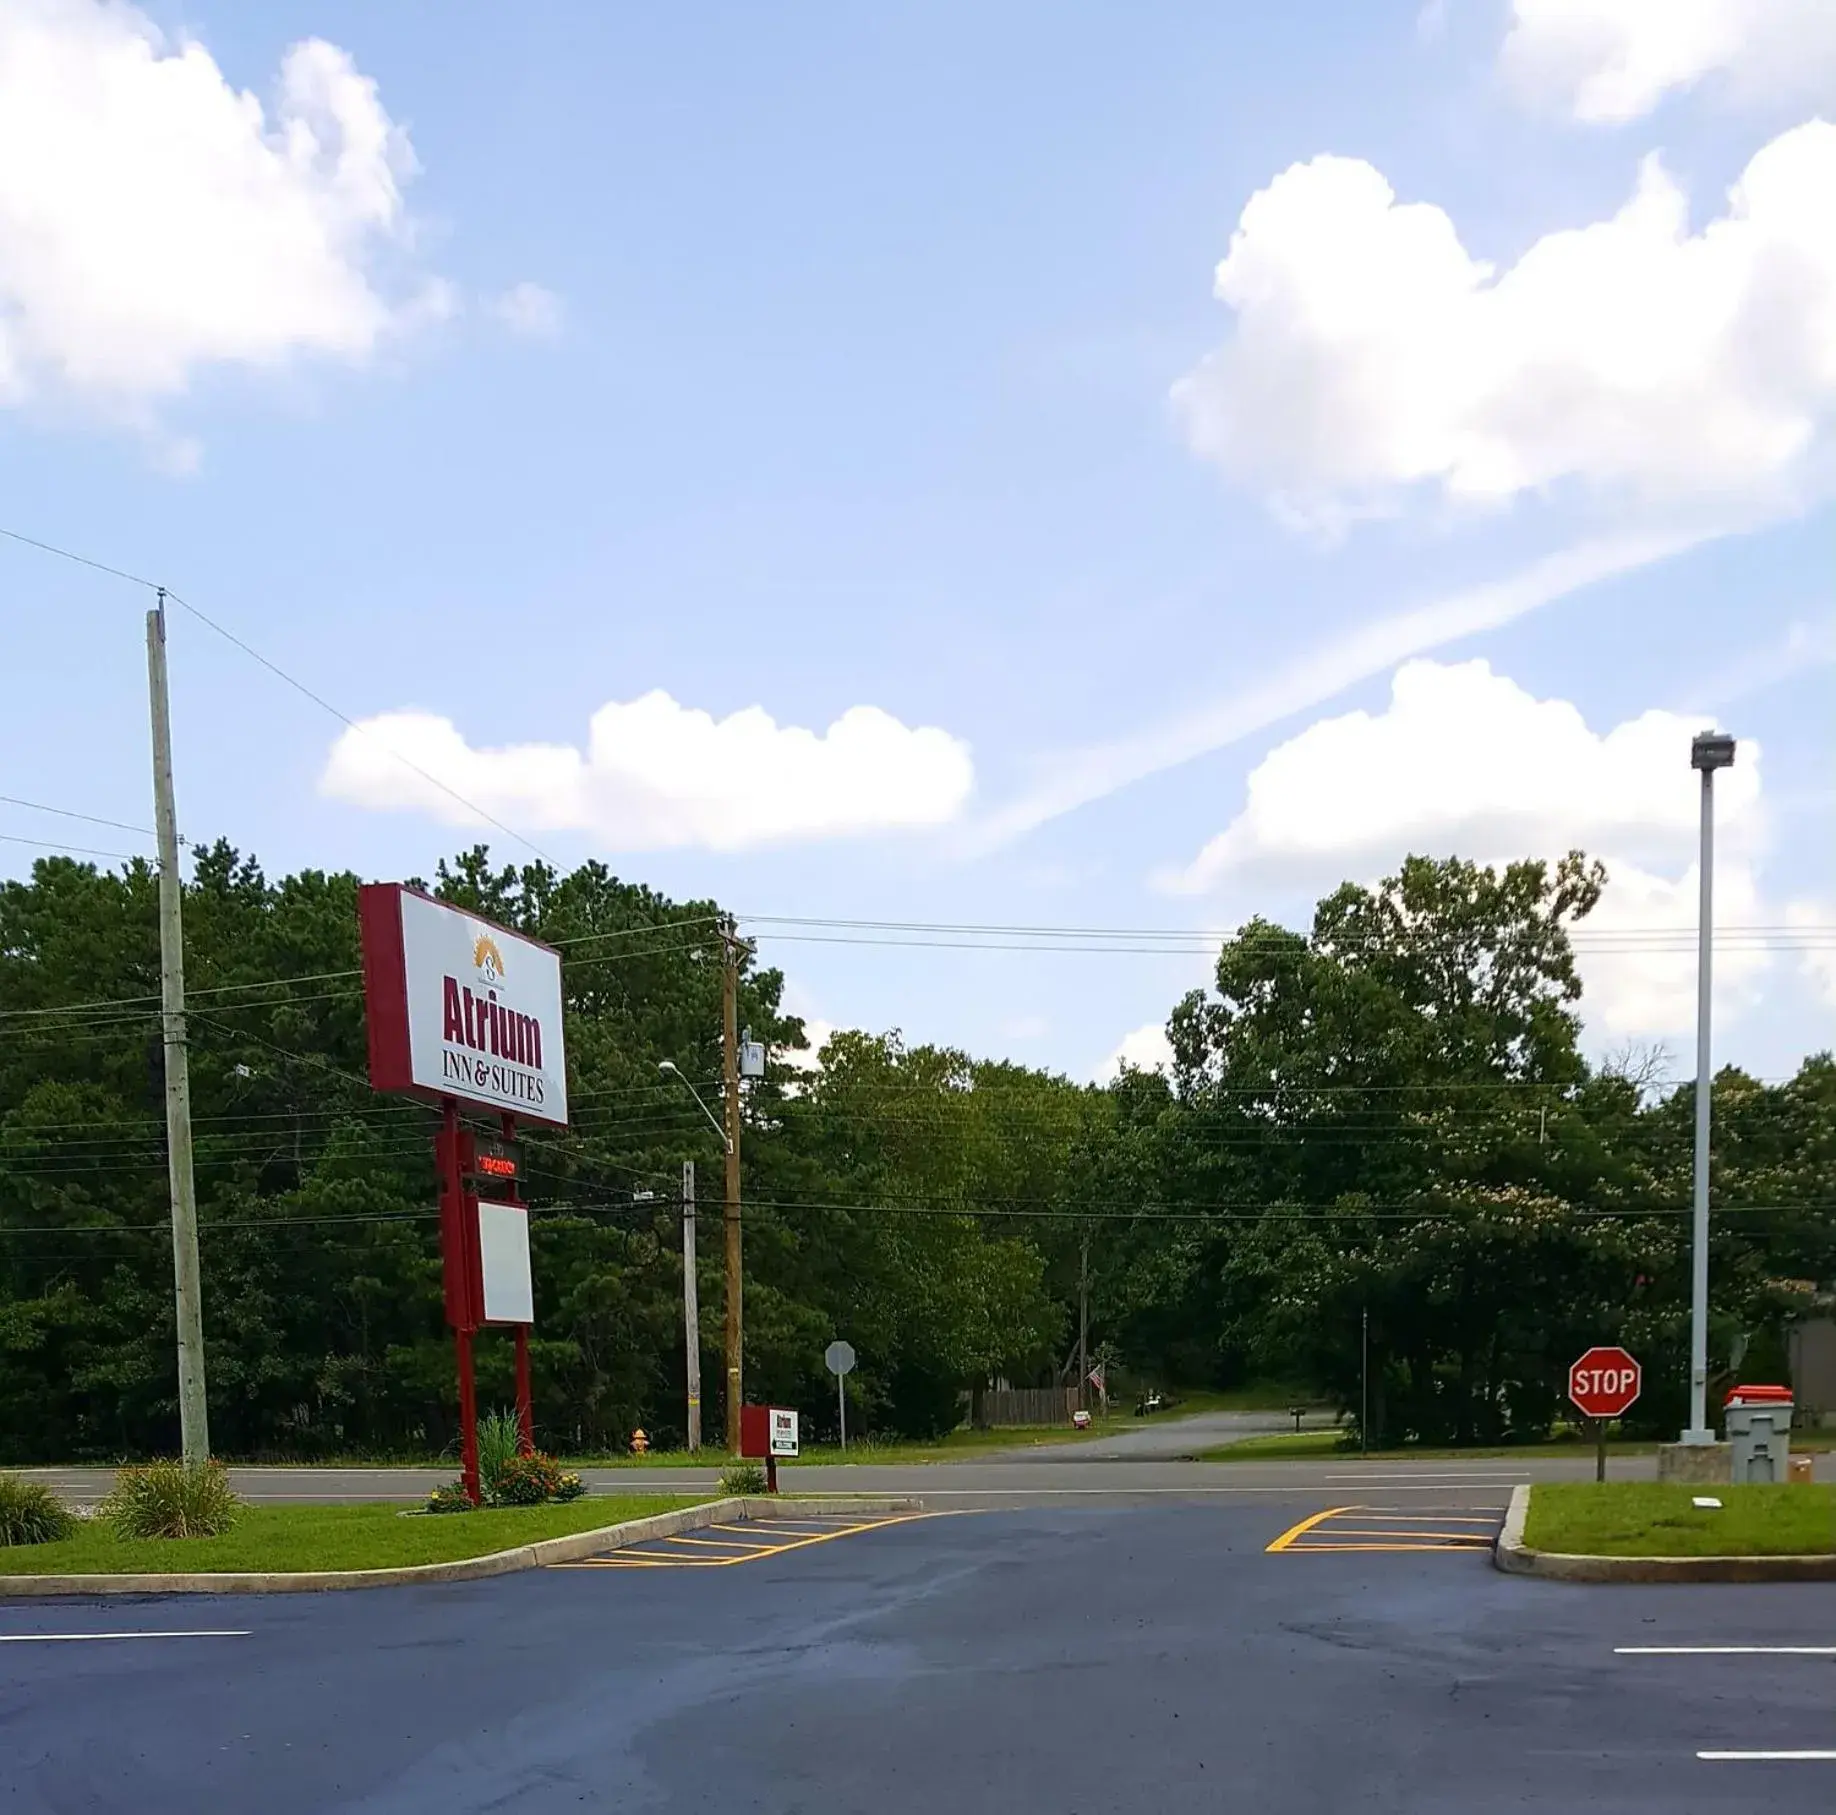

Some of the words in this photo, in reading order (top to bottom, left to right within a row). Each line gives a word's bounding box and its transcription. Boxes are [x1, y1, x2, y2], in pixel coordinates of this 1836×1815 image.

[443, 975, 542, 1070] Atrium
[443, 1050, 472, 1082] INN
[474, 1060, 490, 1087] &
[491, 1064, 544, 1104] SUITES
[1574, 1369, 1635, 1395] STOP
